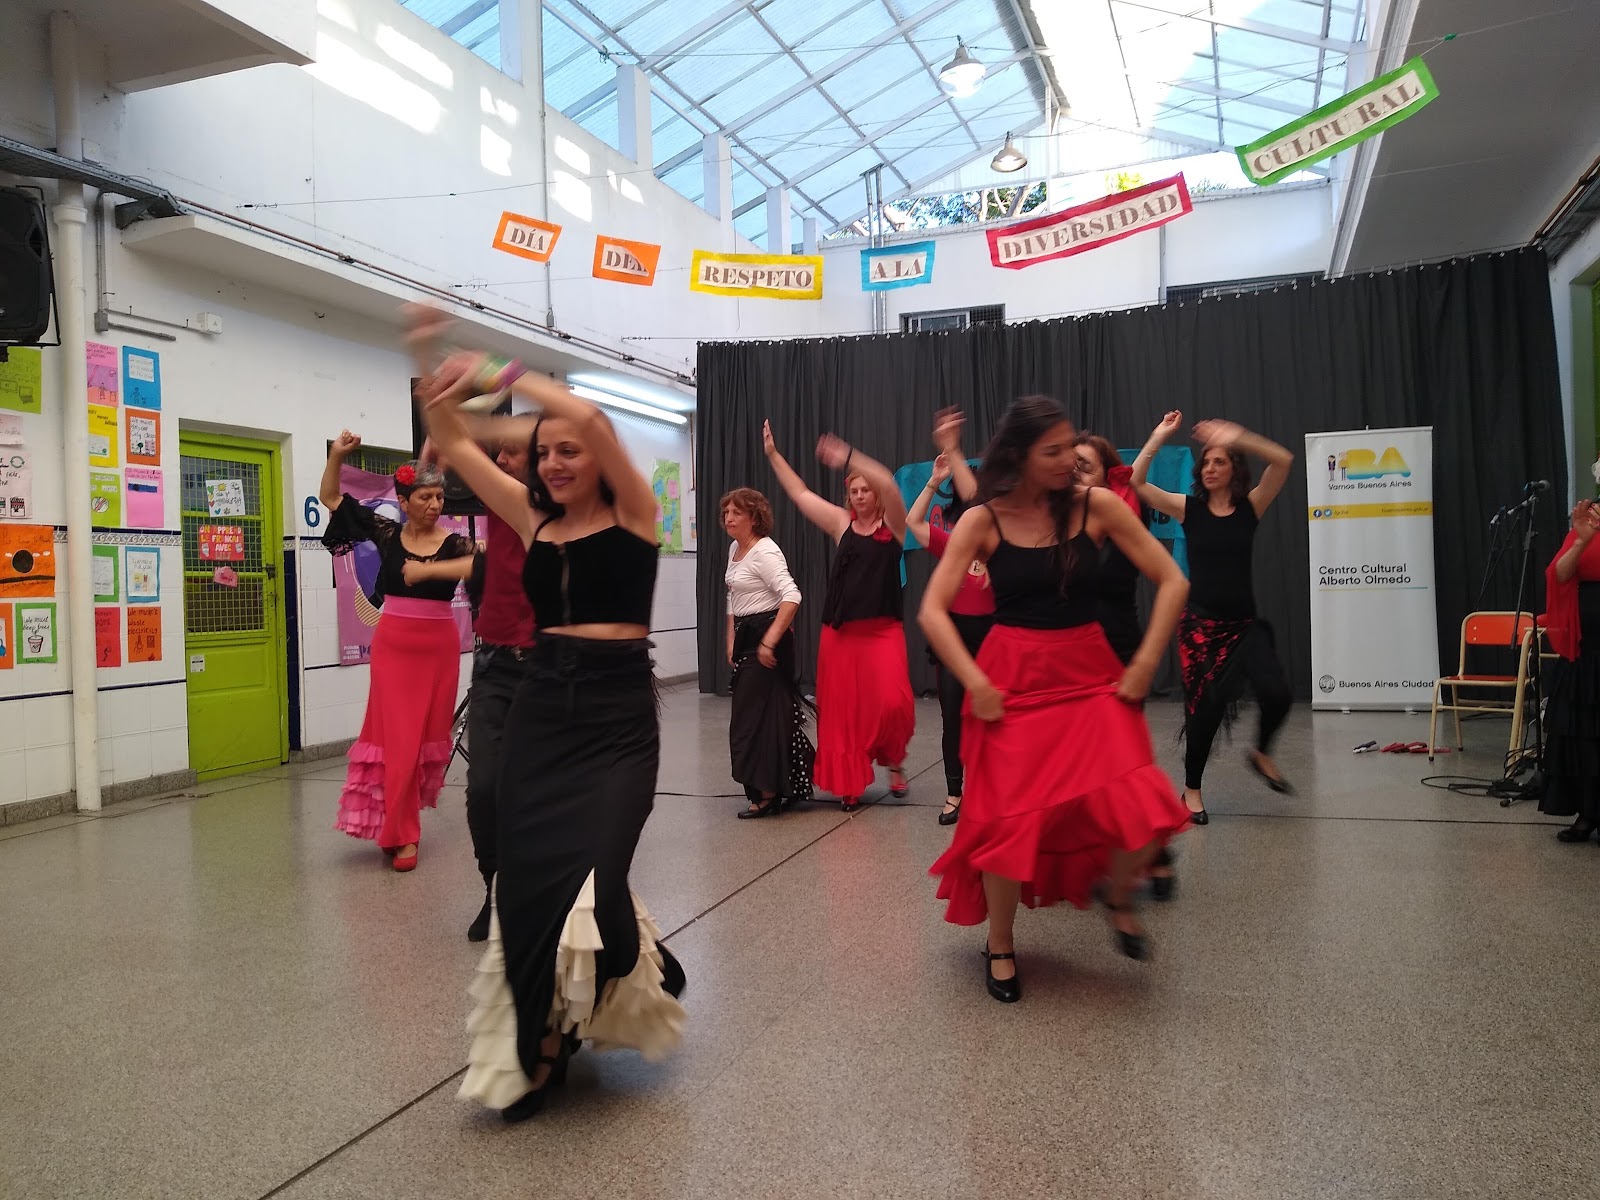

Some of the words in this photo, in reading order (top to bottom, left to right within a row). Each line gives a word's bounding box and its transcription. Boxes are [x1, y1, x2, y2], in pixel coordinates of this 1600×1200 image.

[1253, 83, 1420, 173] CULTURAL
[1003, 194, 1178, 259] DIVERSIDAD
[510, 229, 544, 251] DÍA
[704, 265, 812, 287] RESPETO
[873, 262, 887, 279] A
[895, 258, 922, 278] LA
[1328, 483, 1355, 491] Vamos
[1390, 480, 1412, 488] Aires
[304, 495, 321, 528] 6
[215, 543, 232, 551] AVEC
[1319, 565, 1357, 575] Centro
[1361, 563, 1407, 573] Cultural
[1319, 576, 1361, 586] Alberto
[1365, 574, 1411, 584] Olmedo
[1339, 680, 1372, 688] Buenos
[1374, 680, 1399, 688] Aires
[1401, 680, 1435, 688] Ciudad
